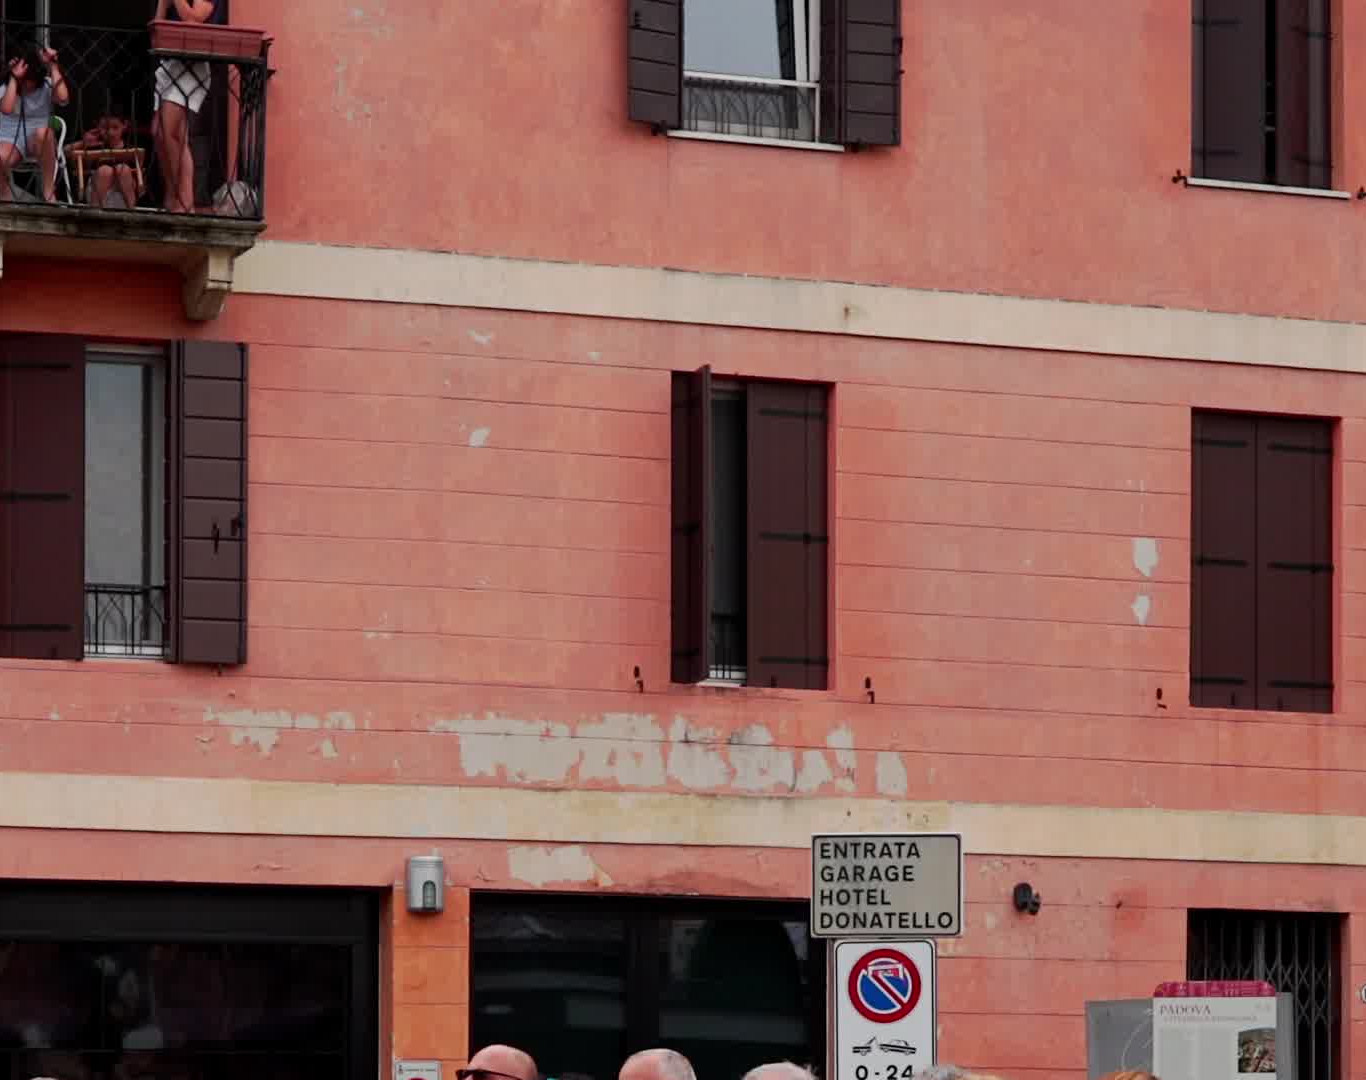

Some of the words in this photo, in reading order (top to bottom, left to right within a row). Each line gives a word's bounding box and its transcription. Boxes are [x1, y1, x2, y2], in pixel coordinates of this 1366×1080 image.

[820, 842, 921, 859] ENTRATA
[820, 865, 915, 882] GARAGE
[820, 888, 891, 906] HOTEL
[820, 911, 953, 930] DONATELLO
[1160, 1005, 1211, 1016] PADOVA
[886, 1064, 914, 1080] 24
